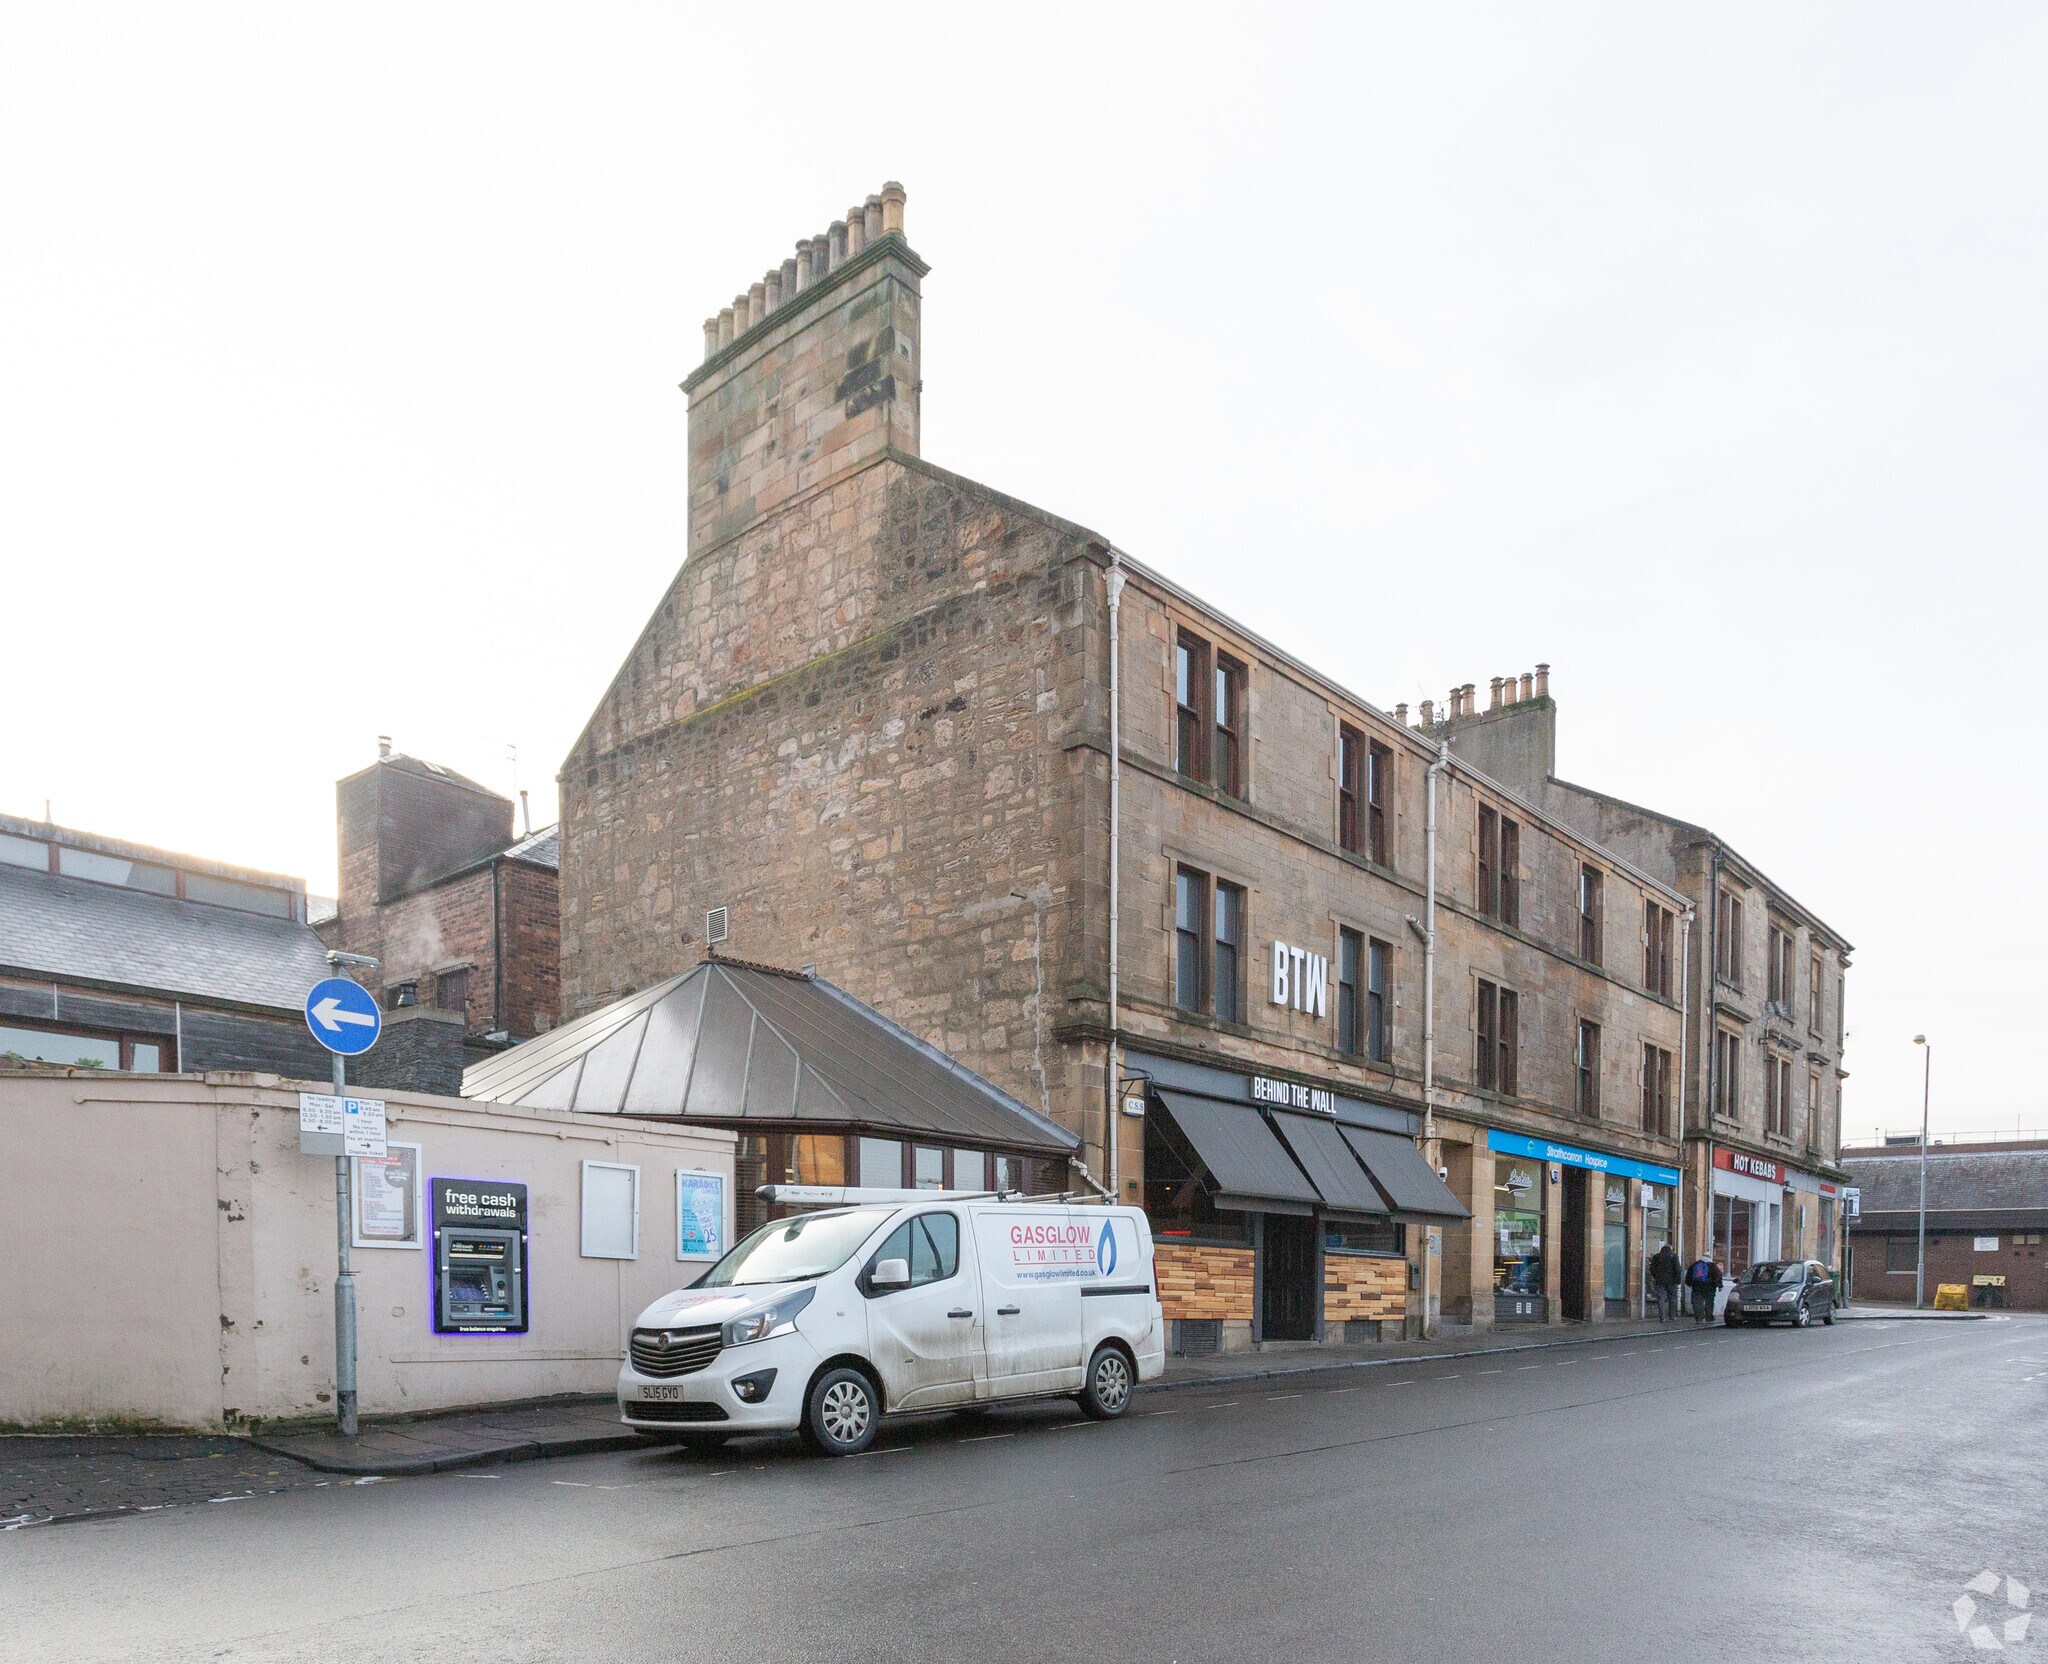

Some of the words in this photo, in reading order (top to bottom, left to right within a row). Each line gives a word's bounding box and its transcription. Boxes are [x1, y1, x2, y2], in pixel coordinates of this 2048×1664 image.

[1272, 940, 1327, 1017] BTW
[1253, 1076, 1289, 1106] BEHIND
[1290, 1083, 1309, 1109] THE
[1311, 1089, 1337, 1114] WALL
[347, 1101, 357, 1113] P
[1546, 1144, 1583, 1164] Strathcarron
[1584, 1152, 1608, 1169] Hospice
[1733, 1153, 1749, 1173] HOT
[1749, 1158, 1776, 1180] KEBABS
[681, 1178, 720, 1191] KARAOKE
[445, 1188, 477, 1204] free
[481, 1193, 516, 1207] cash
[445, 1204, 516, 1218] withdrawals
[703, 1227, 717, 1244] 25
[1010, 1225, 1090, 1244] GASGLOW
[1013, 1249, 1096, 1262] LIMITED
[1016, 1268, 1096, 1280] www.gasglowlimited.co.uk
[643, 1387, 661, 1399] SL15
